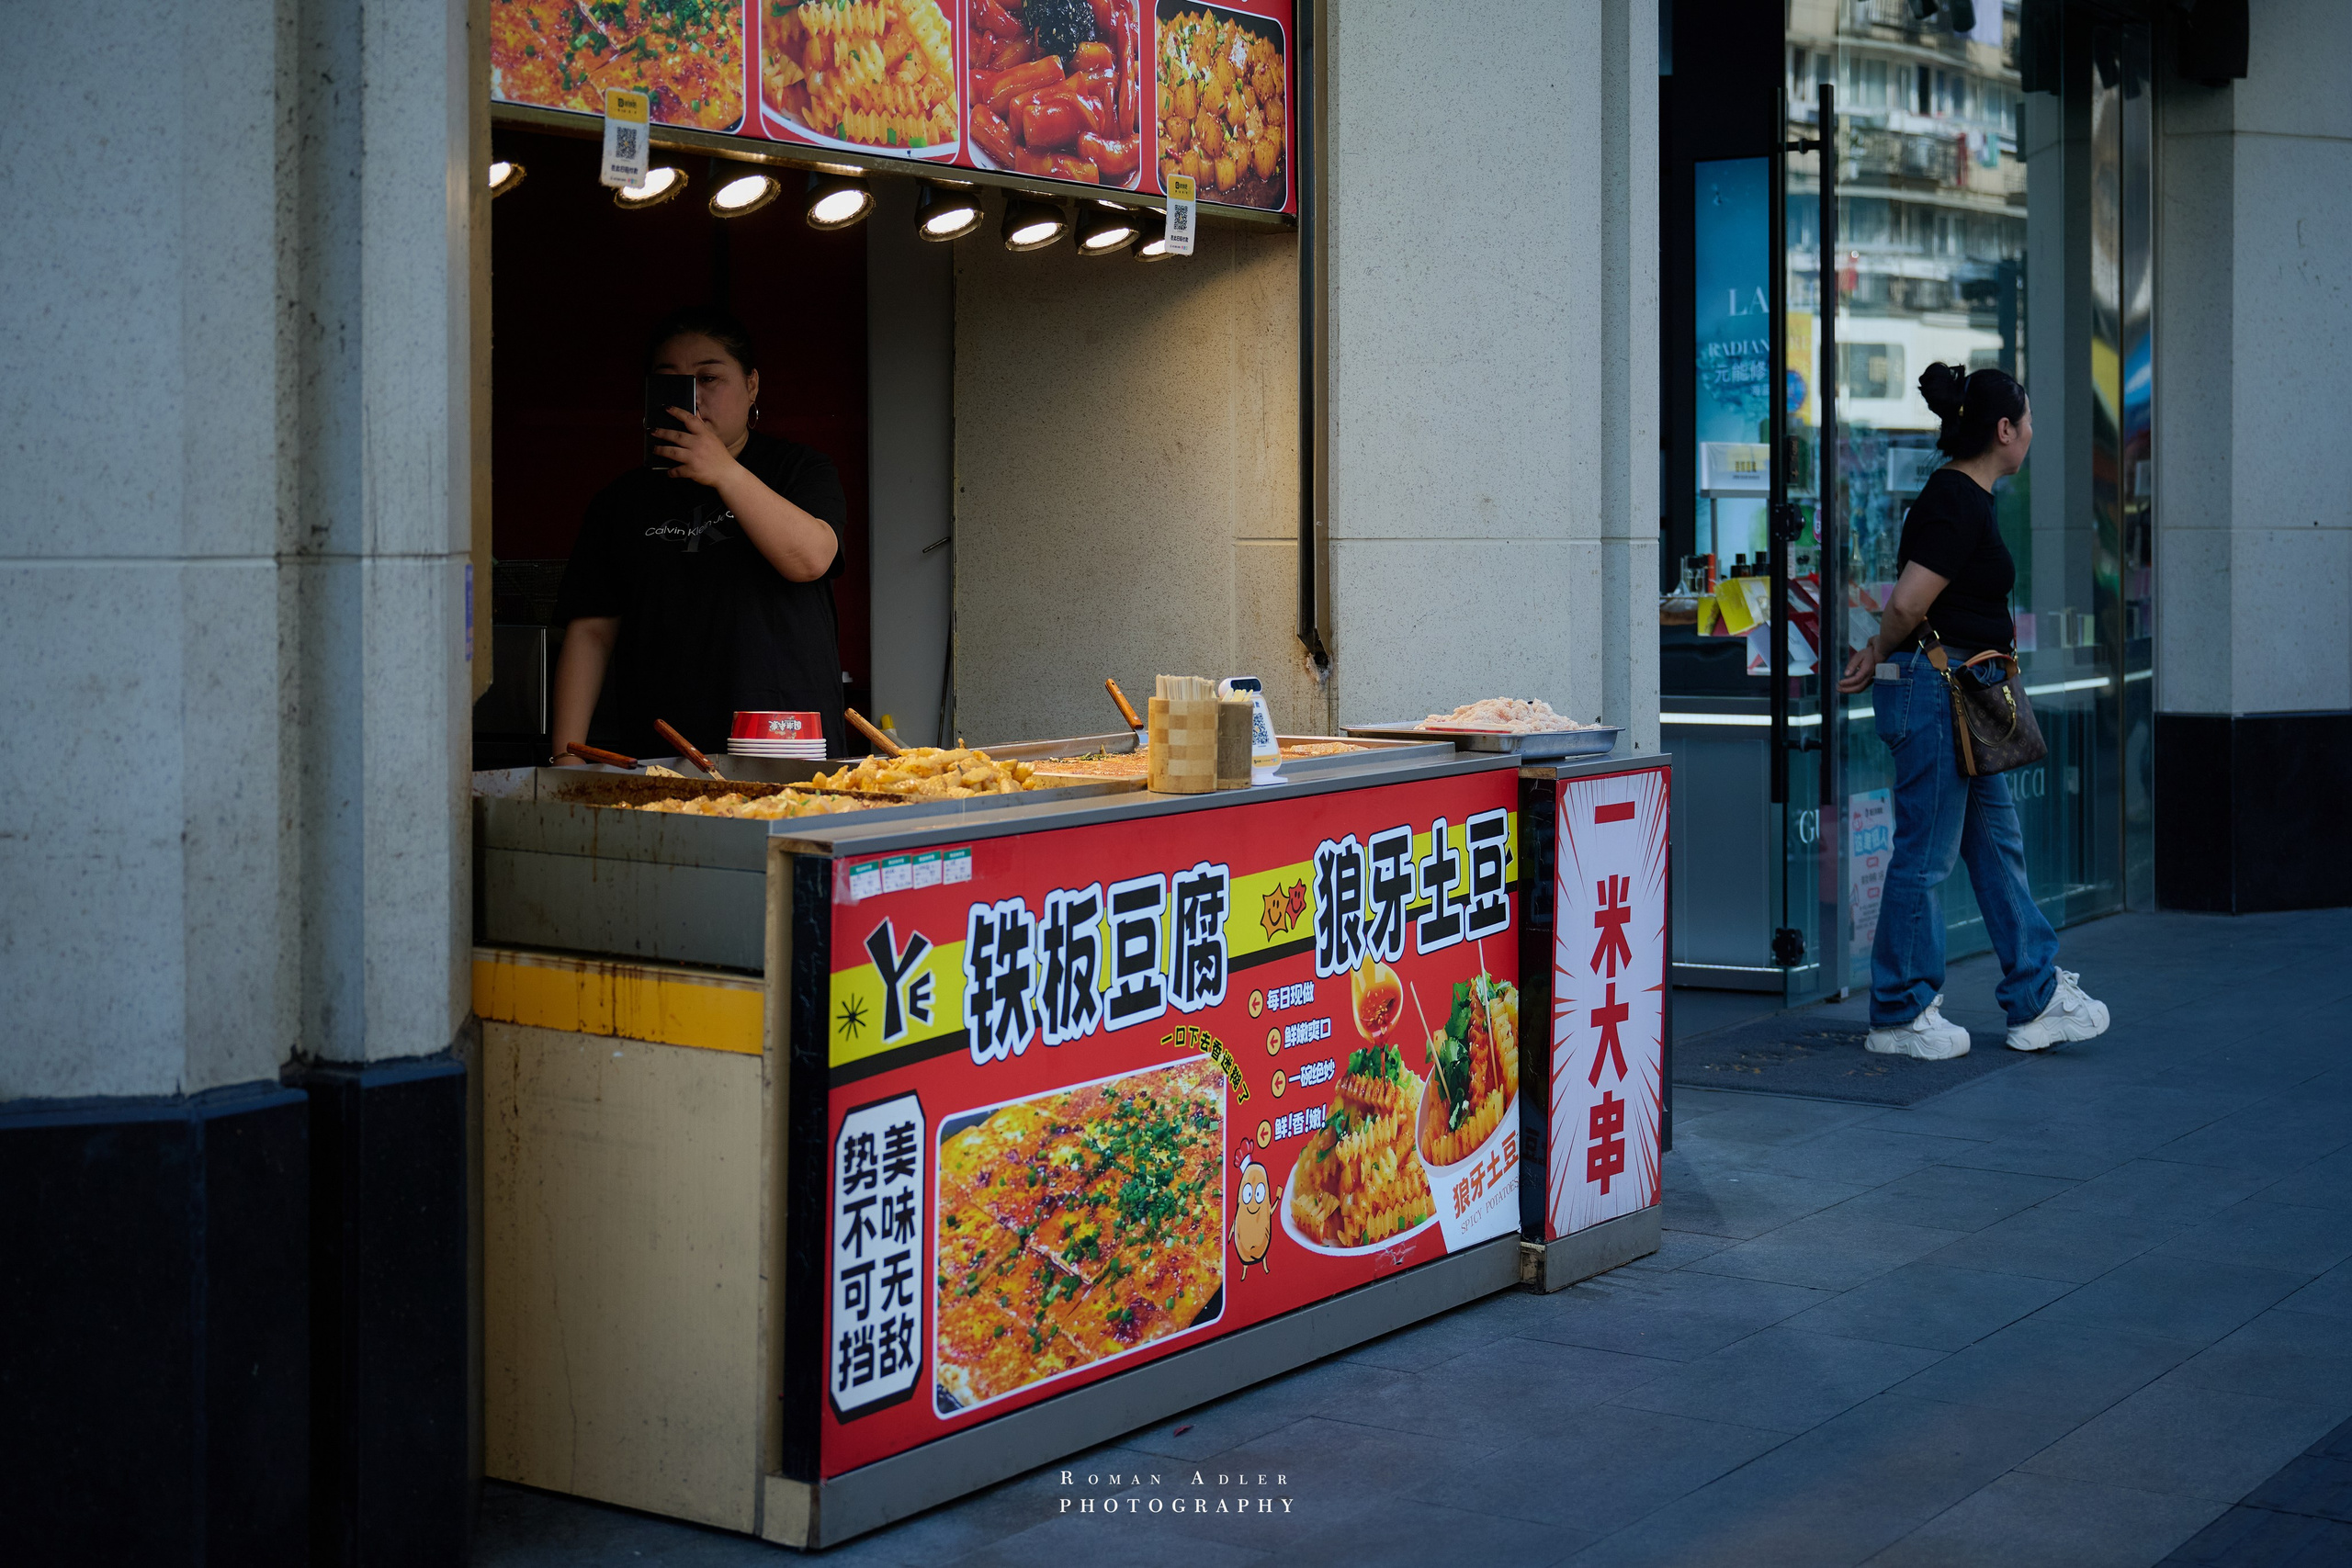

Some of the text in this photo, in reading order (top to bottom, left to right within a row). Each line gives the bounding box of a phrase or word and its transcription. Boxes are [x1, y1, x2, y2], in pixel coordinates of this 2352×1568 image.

[645, 525, 685, 536] Calvin
[687, 520, 712, 536] Klein
[1314, 807, 1510, 978] 狼牙土豆
[964, 862, 1229, 1065] 铁板豆腐
[1266, 981, 1315, 1011] 每日现做
[1587, 800, 1635, 1196] 一米大串
[1160, 1025, 1250, 1105] 一口下去香迷糊了
[1284, 1017, 1331, 1049] 鲜嫩爽口
[1288, 1057, 1336, 1088] 一碗绝妙
[1453, 1129, 1519, 1220] 狼牙土豆
[1460, 1176, 1520, 1235] SPICY POTATOES
[839, 1132, 877, 1393] 势不可挡
[879, 1121, 917, 1379] 美味无敌
